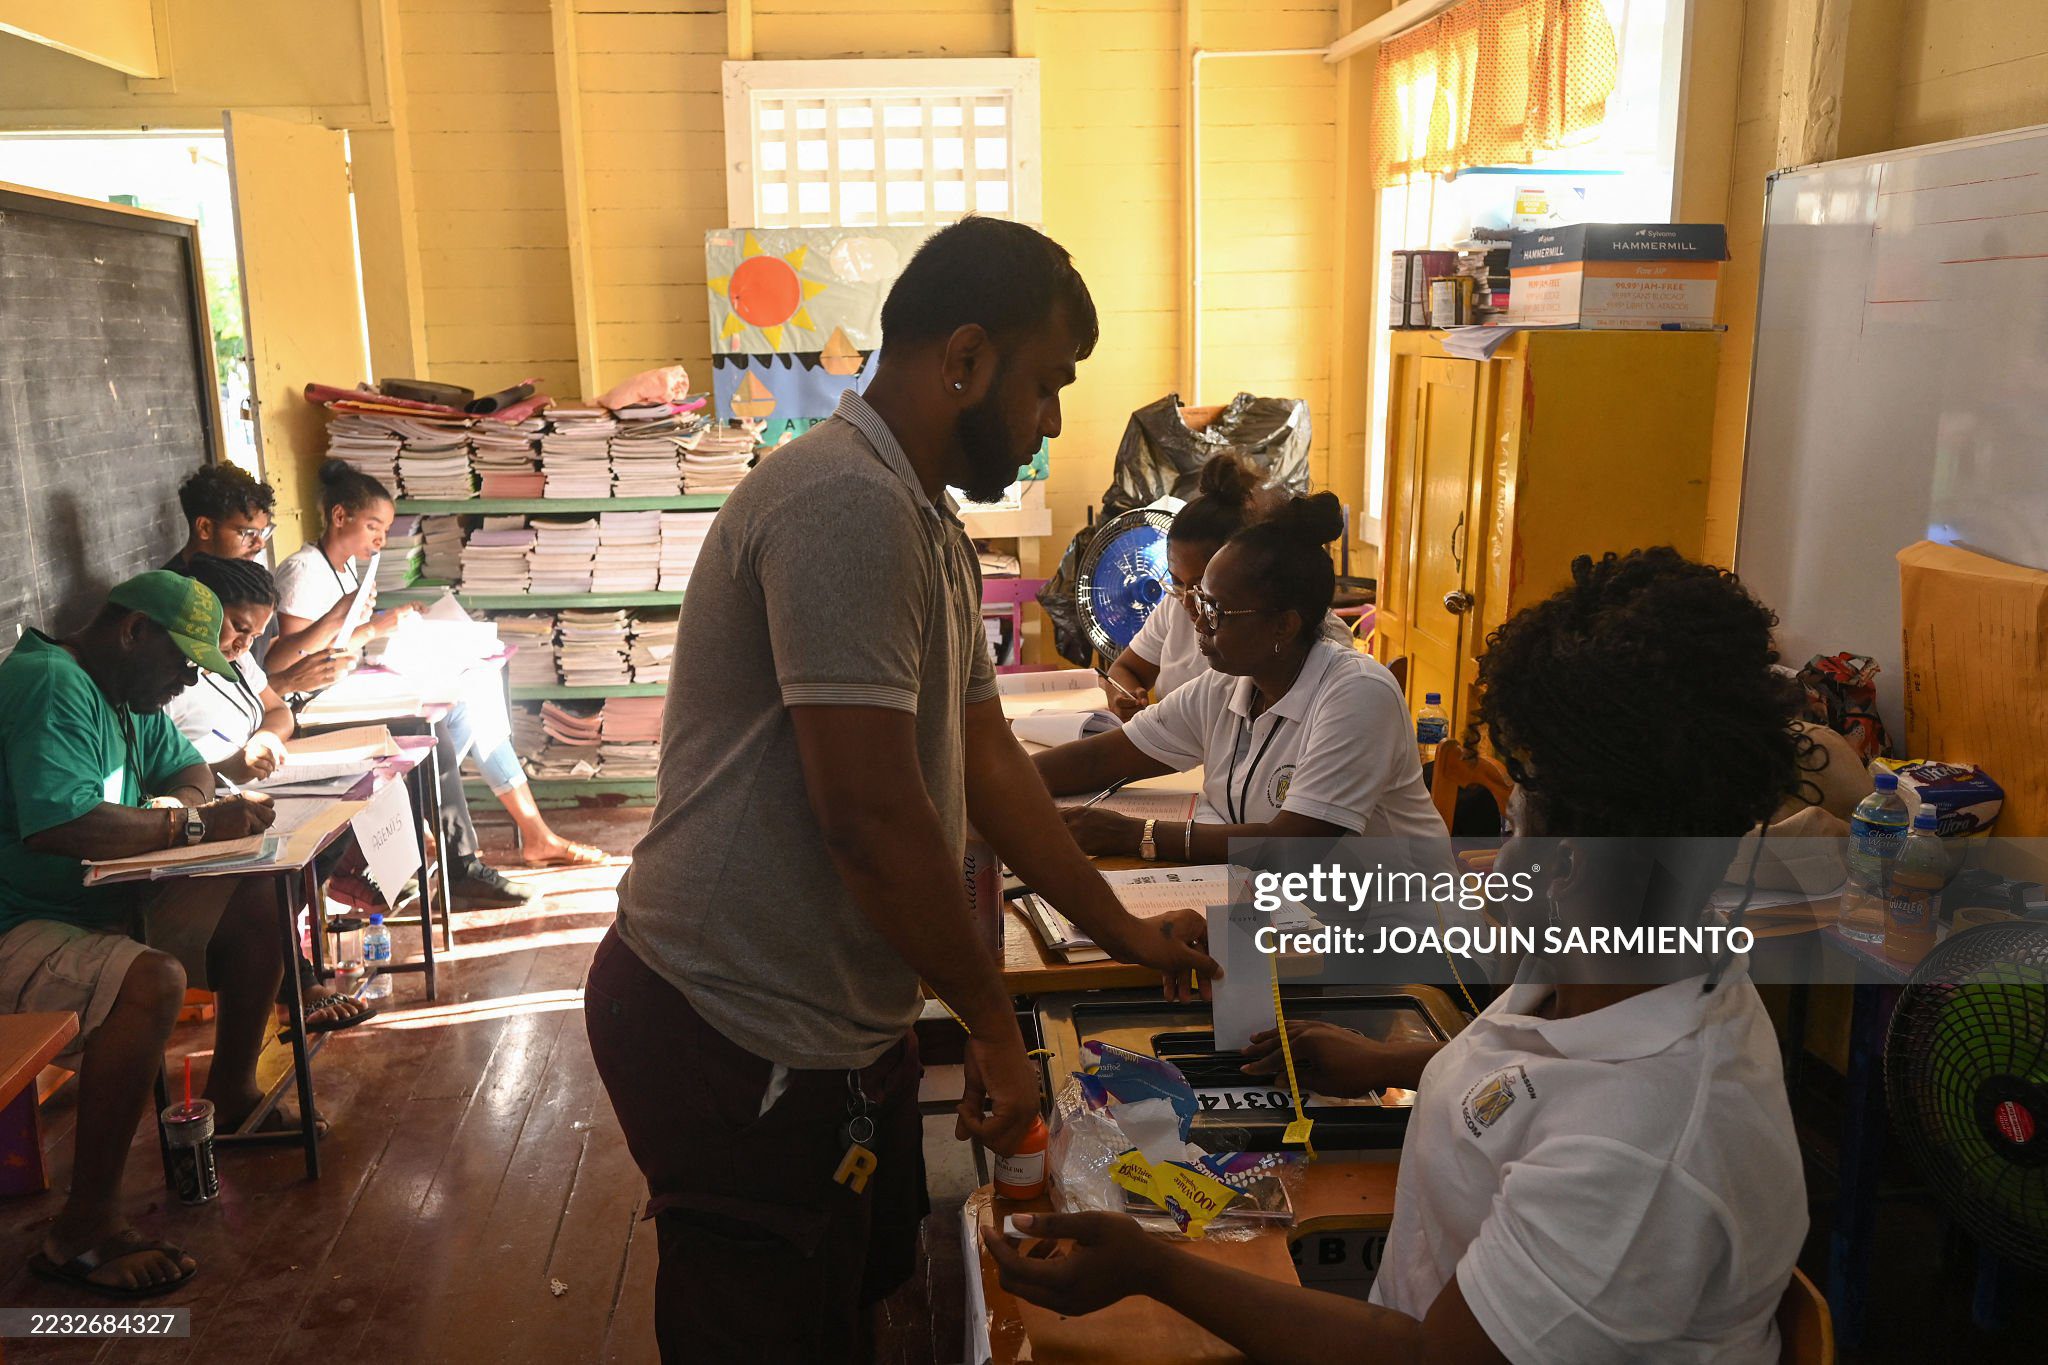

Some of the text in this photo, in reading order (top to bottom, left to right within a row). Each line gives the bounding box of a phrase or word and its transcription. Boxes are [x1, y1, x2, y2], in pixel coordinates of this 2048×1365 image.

[1523, 246, 1565, 260] HAMMERMILL
[1612, 241, 1697, 250] HAMMERMILL
[832, 1143, 878, 1195] R
[1173, 1177, 1195, 1200] White
[1193, 1190, 1217, 1212] 100
[1318, 1238, 1347, 1265] B
